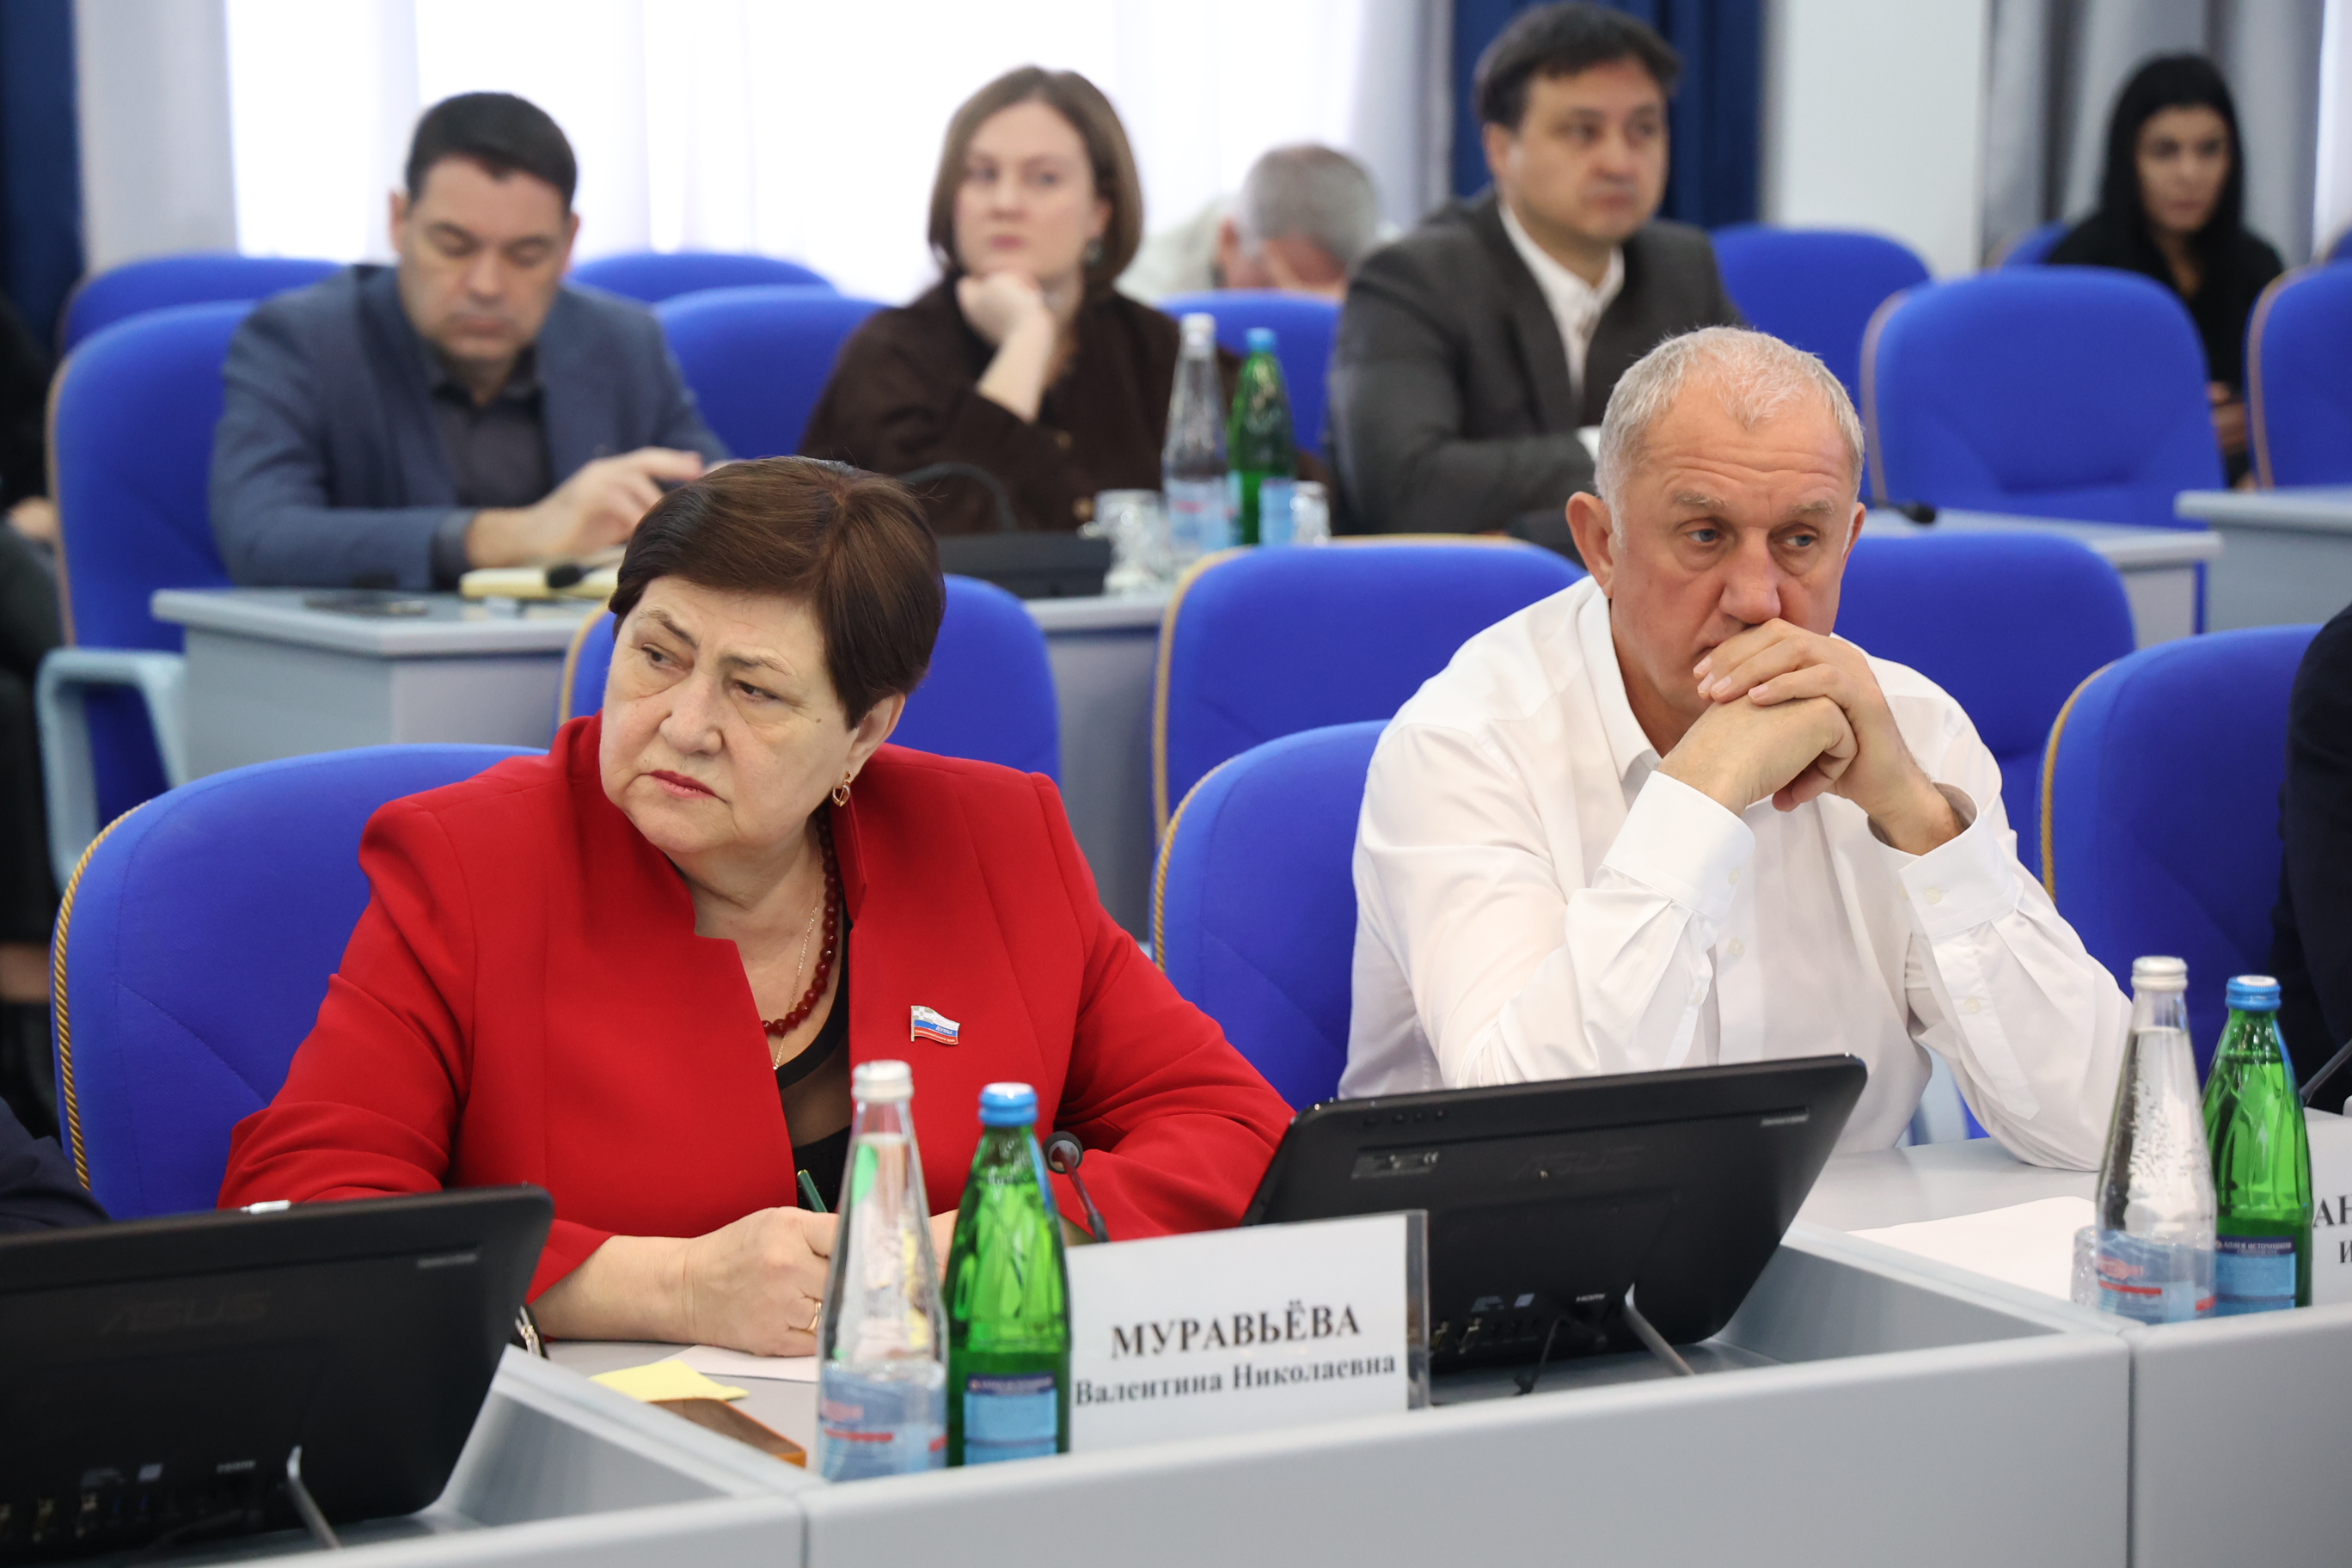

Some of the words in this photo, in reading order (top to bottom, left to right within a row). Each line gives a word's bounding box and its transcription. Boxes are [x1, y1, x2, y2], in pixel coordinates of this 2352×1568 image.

[1112, 1300, 1361, 1359] МУРАВЬЁВА
[1075, 1373, 1223, 1406] Валентина
[1233, 1355, 1396, 1390] Николаевна
